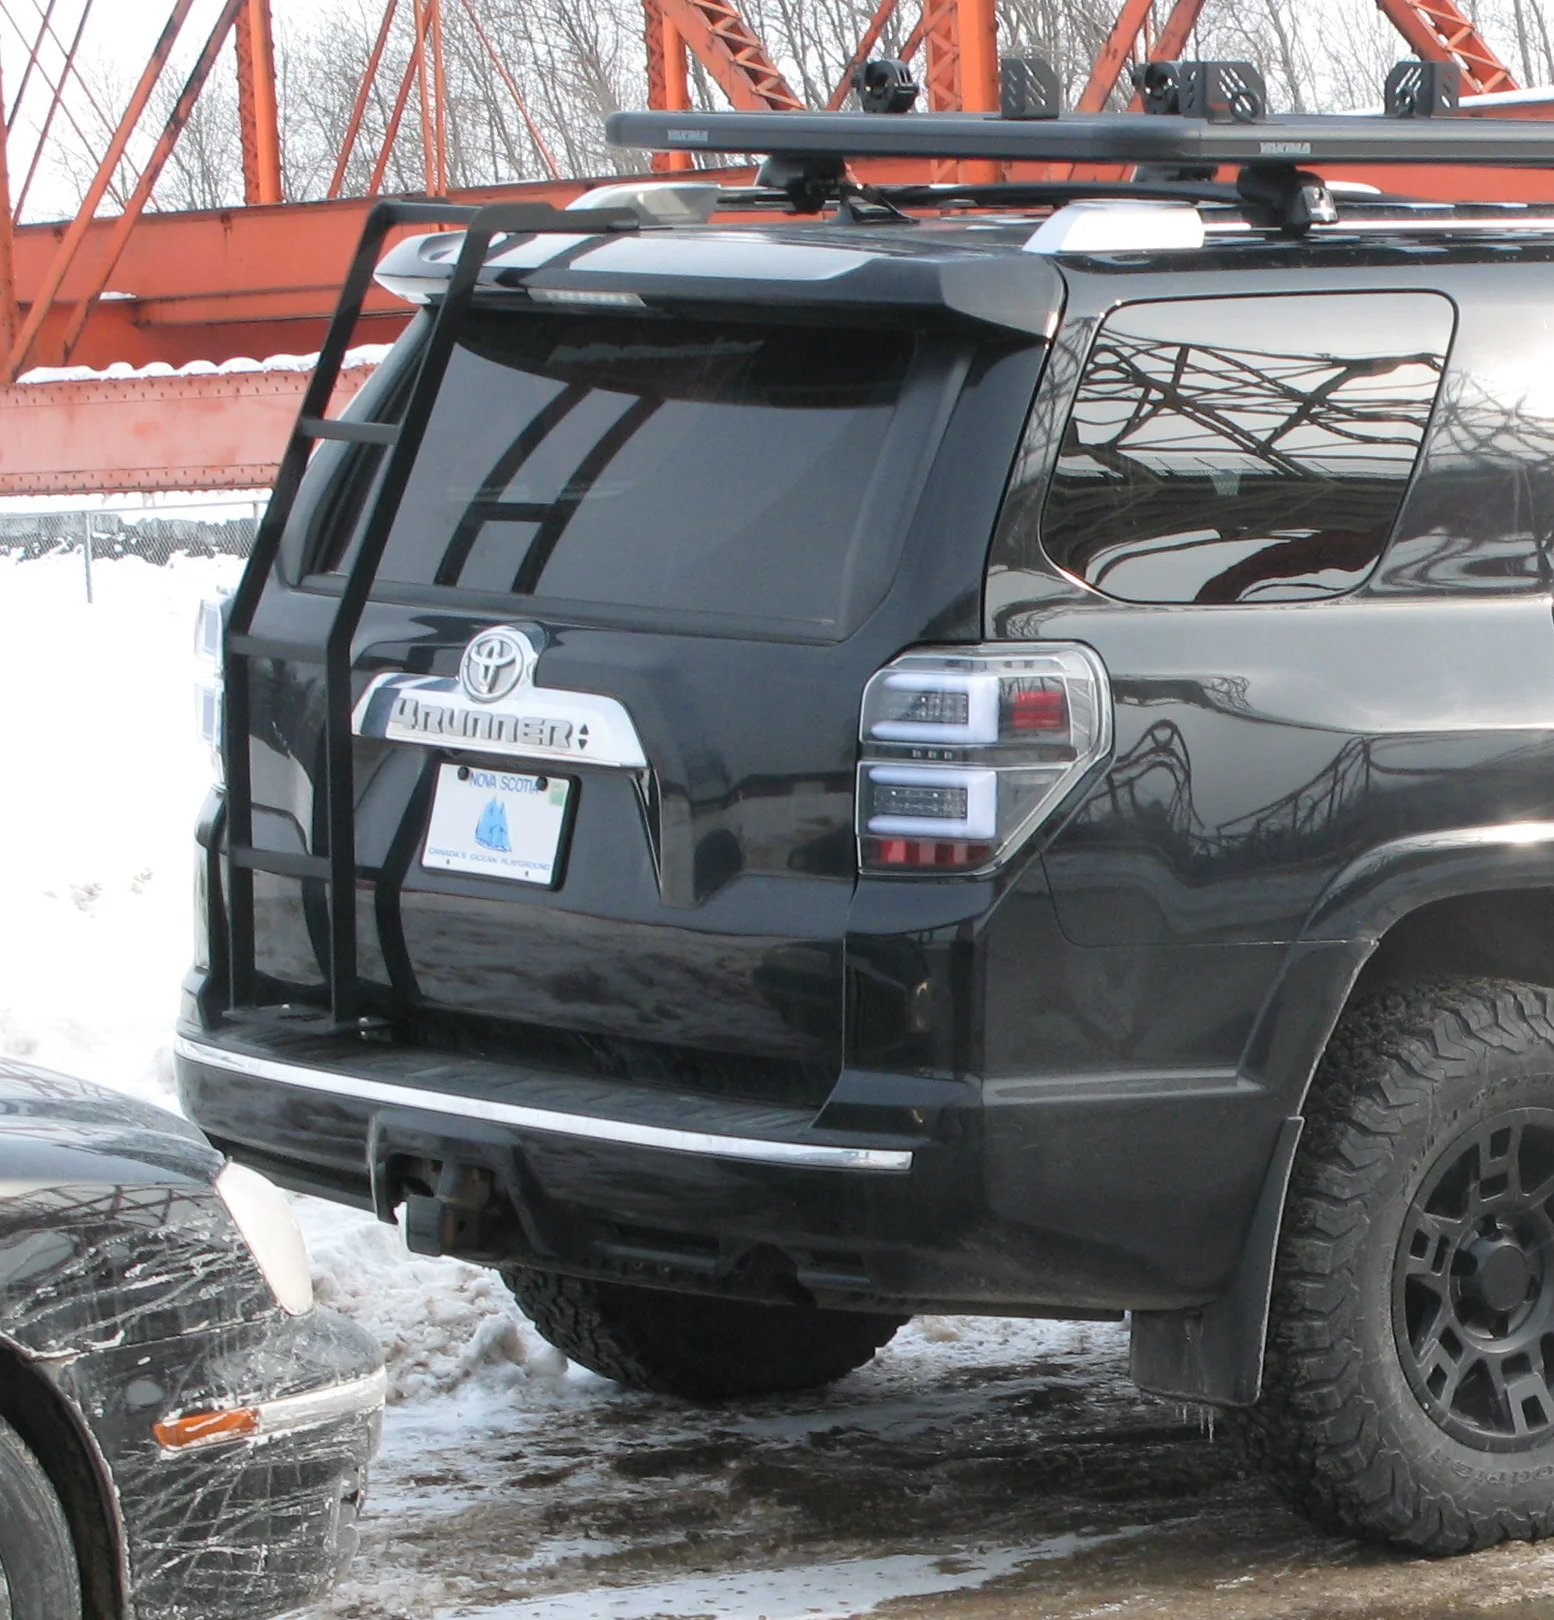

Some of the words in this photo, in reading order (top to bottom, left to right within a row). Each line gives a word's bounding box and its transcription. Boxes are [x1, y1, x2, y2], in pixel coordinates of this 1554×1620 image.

[390, 698, 573, 748] 4RUNNER
[470, 771, 497, 789] NOVA
[501, 775, 540, 795] SCOTIA
